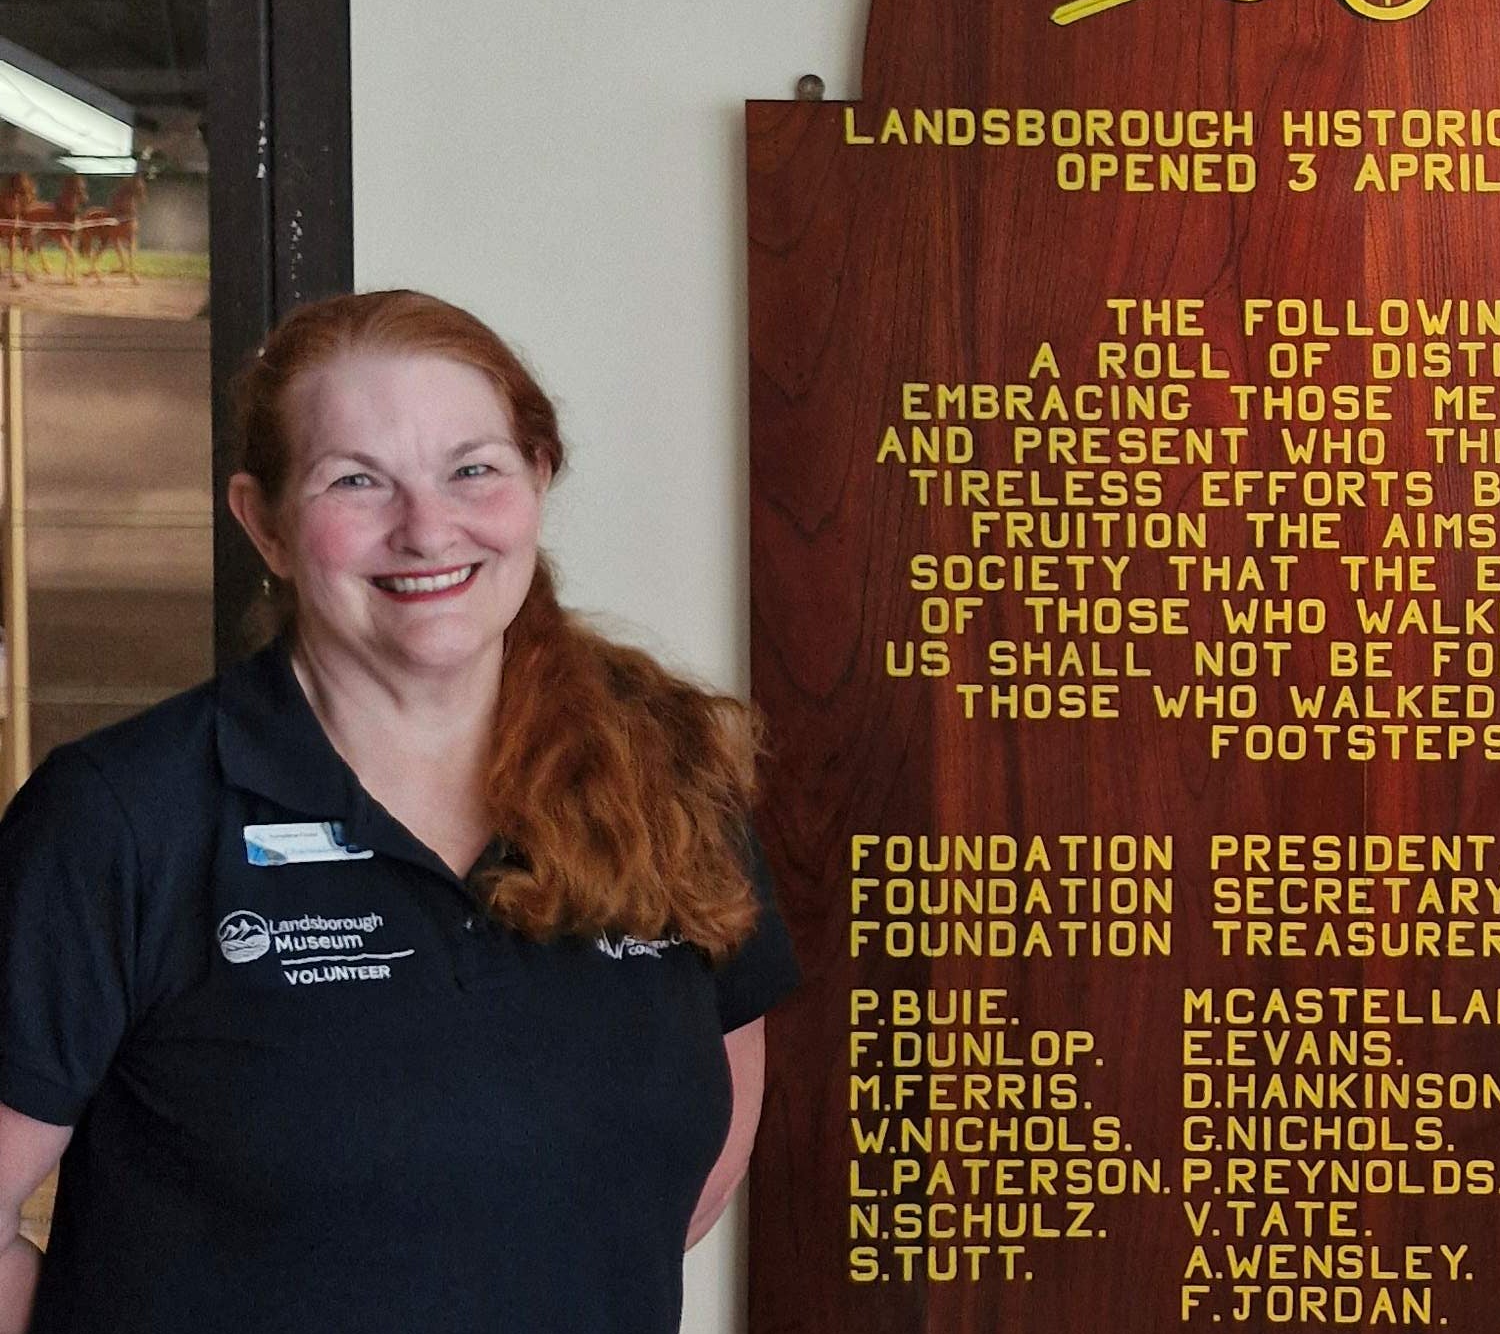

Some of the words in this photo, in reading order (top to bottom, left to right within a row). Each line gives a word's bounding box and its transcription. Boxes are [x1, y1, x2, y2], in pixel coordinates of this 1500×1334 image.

[844, 108, 1253, 149] LANDSBOROUGH
[1056, 153, 1256, 193] OPENED
[1289, 153, 1317, 193] 3
[1108, 299, 1203, 336] THE
[1029, 342, 1059, 380] A
[1098, 342, 1227, 380] ROLL
[1269, 342, 1329, 380] OF
[902, 383, 1190, 421] EMBRACING
[1230, 383, 1391, 421] THOSE
[876, 426, 975, 465] AND
[1013, 426, 1246, 465] PRESENT
[1283, 426, 1386, 465] WHO
[909, 470, 1162, 507] TIRELESS
[1202, 470, 1434, 507] EFFORTS
[971, 511, 1206, 549] FRUITION
[1247, 511, 1340, 549] THE
[1383, 511, 1496, 549] AIMS
[910, 555, 1128, 593] SOCIETY
[1168, 555, 1298, 593] THAT
[1342, 555, 1435, 593] THE
[921, 597, 982, 636] OF
[1025, 597, 1189, 636] THOSE
[1222, 597, 1327, 636] WHO
[885, 641, 951, 678] US
[988, 641, 1152, 678] SHALL
[1194, 641, 1291, 678] NOT
[1330, 641, 1392, 678] BE
[958, 684, 1119, 720] THOSE
[1153, 684, 1258, 720] WHO
[1290, 684, 1496, 720] WALKED
[851, 834, 1173, 875] FOUNDATION
[851, 877, 1173, 916] FOUNDATION
[268, 913, 384, 935] Landsborough
[851, 920, 1172, 958] FOUNDATION
[274, 933, 364, 954] Museum
[283, 964, 392, 986] VOLUNTEER
[850, 989, 1020, 1026] P.BUIE.
[849, 1031, 1103, 1068] F.DUNLOP.
[1183, 1031, 1404, 1068] E.EVANS.
[849, 1073, 1093, 1111] M.FERRIS.
[851, 1116, 1132, 1154] W.NICHOLS.
[1183, 1116, 1455, 1154] G.NICHOLS.
[849, 1159, 1170, 1197] L.PATERSON.
[849, 1201, 1107, 1240] N.SCHULZ.
[1184, 1201, 1372, 1240] V.TATE.
[849, 1244, 1033, 1282] S.TUTT.
[1184, 1244, 1474, 1282] A.WENSLEY.
[1181, 1285, 1447, 1324] F.JORDAN.
